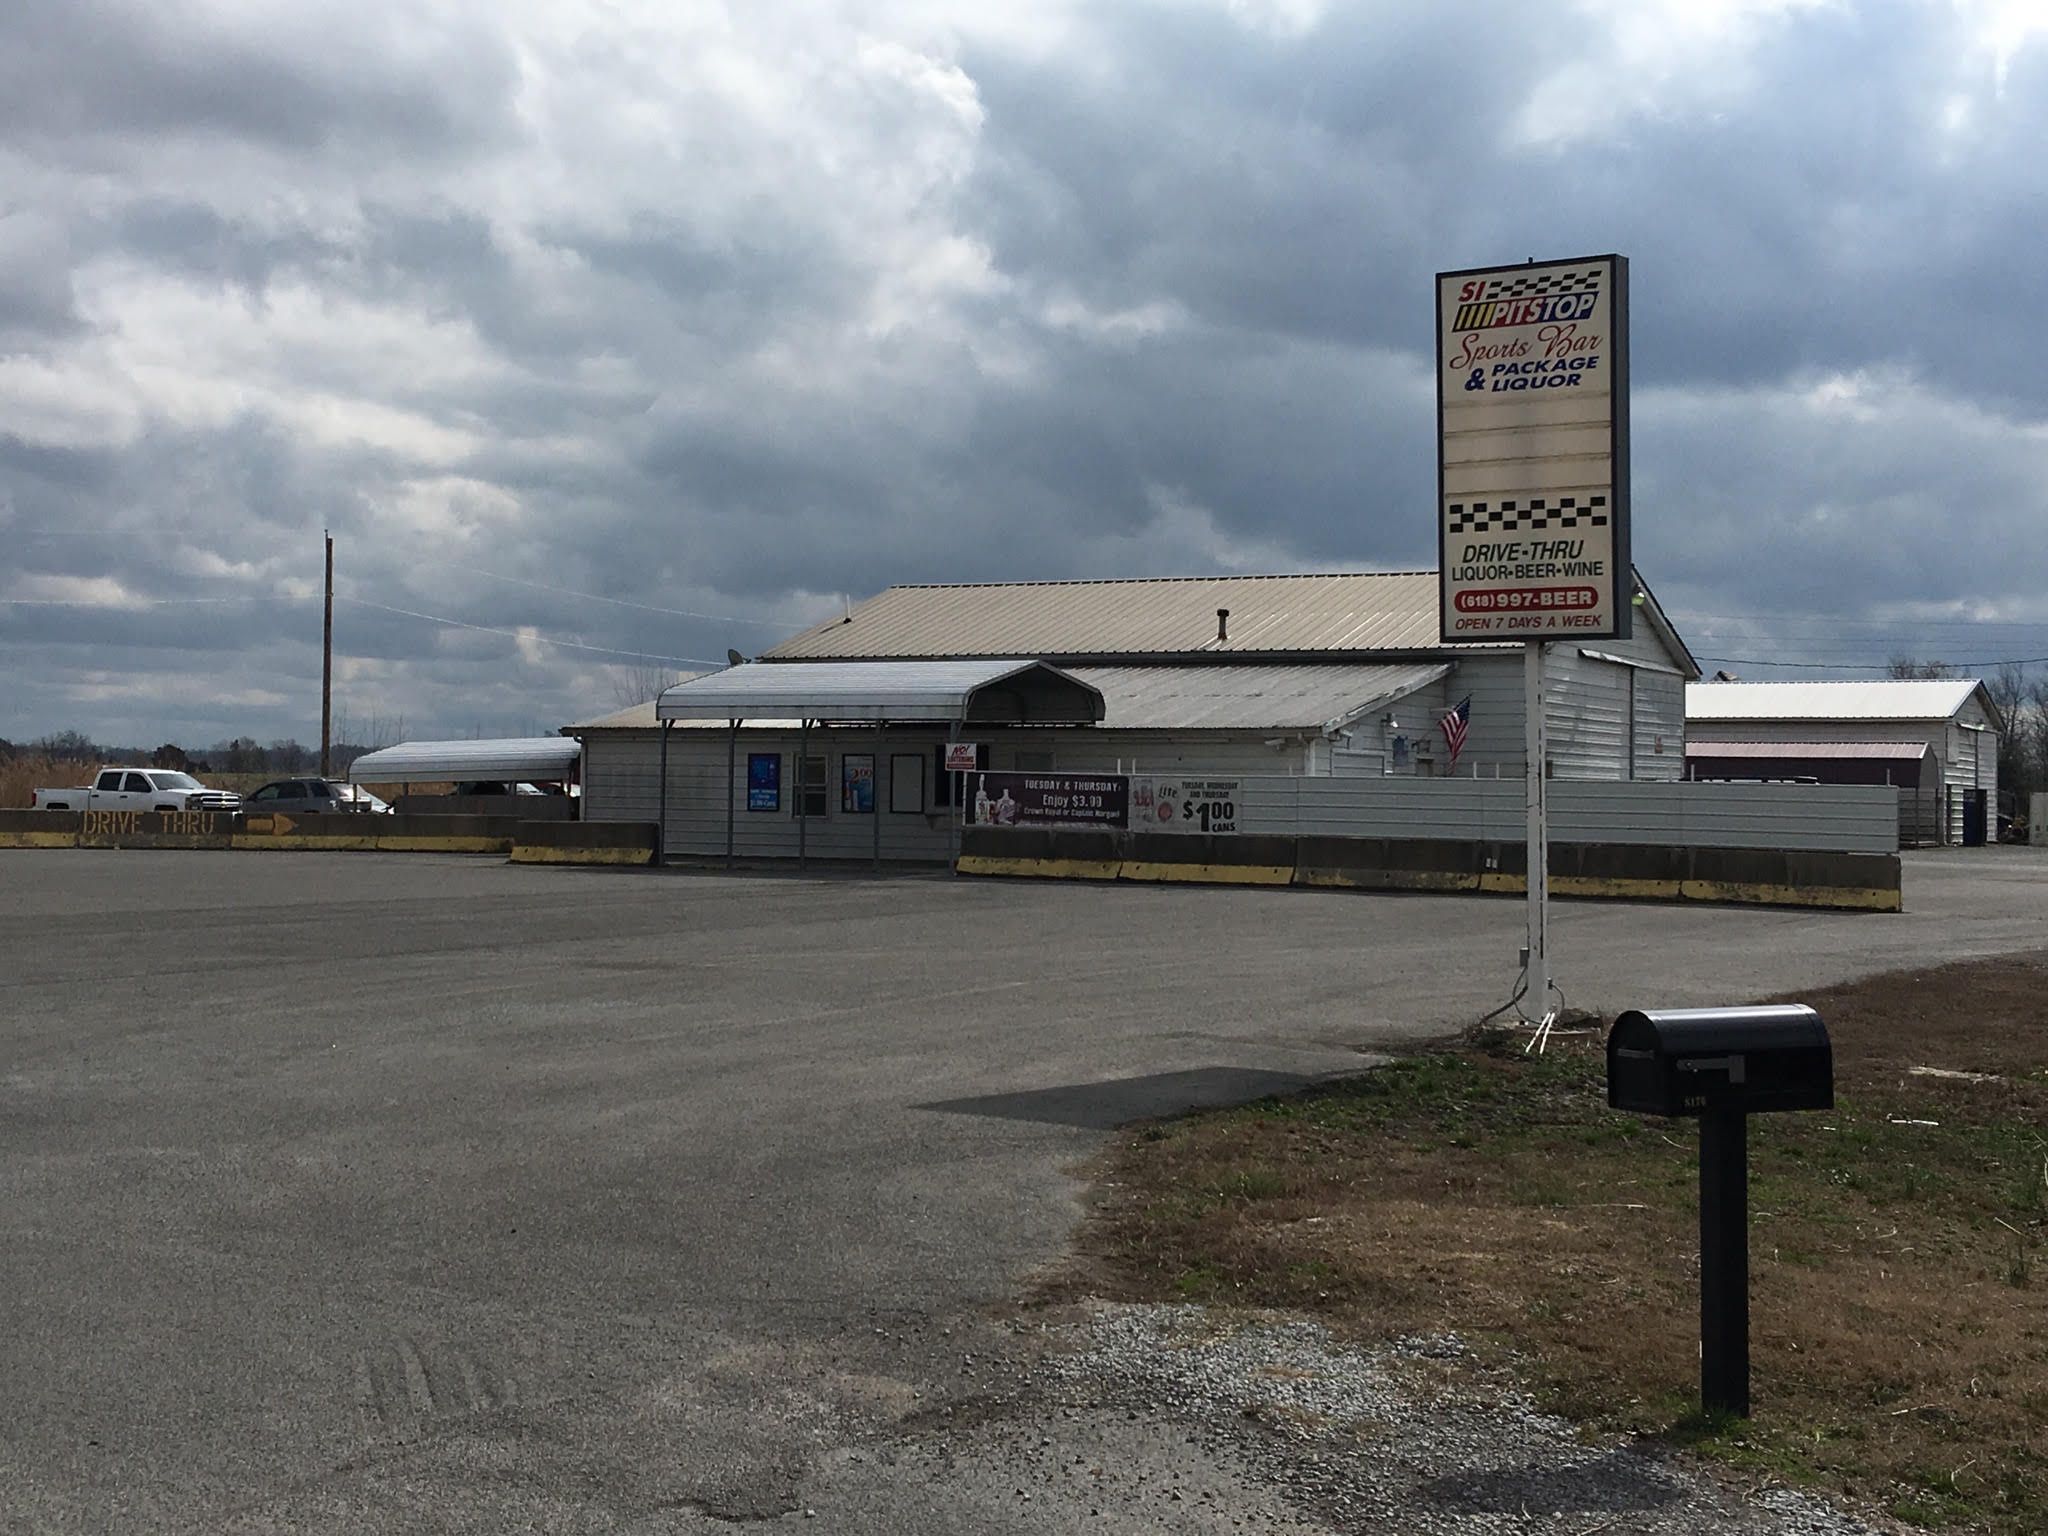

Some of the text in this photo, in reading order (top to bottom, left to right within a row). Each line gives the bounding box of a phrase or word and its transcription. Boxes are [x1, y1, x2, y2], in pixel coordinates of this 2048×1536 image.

[1458, 281, 1486, 302] SI
[1449, 323, 1603, 370] Sports Bar
[1464, 356, 1600, 392] & PACKAGE
[1491, 373, 1582, 392] LIQUOR
[1455, 614, 1602, 630] OPEN 7 DAYS A WEEK
[1024, 779, 1060, 791] TUESDAY
[1064, 780, 1071, 791] &
[1158, 785, 1178, 799] Lite
[1043, 794, 1102, 808] Enjoy $3.00
[83, 811, 215, 834] DRIVE THRU
[1212, 822, 1236, 833] CANS
